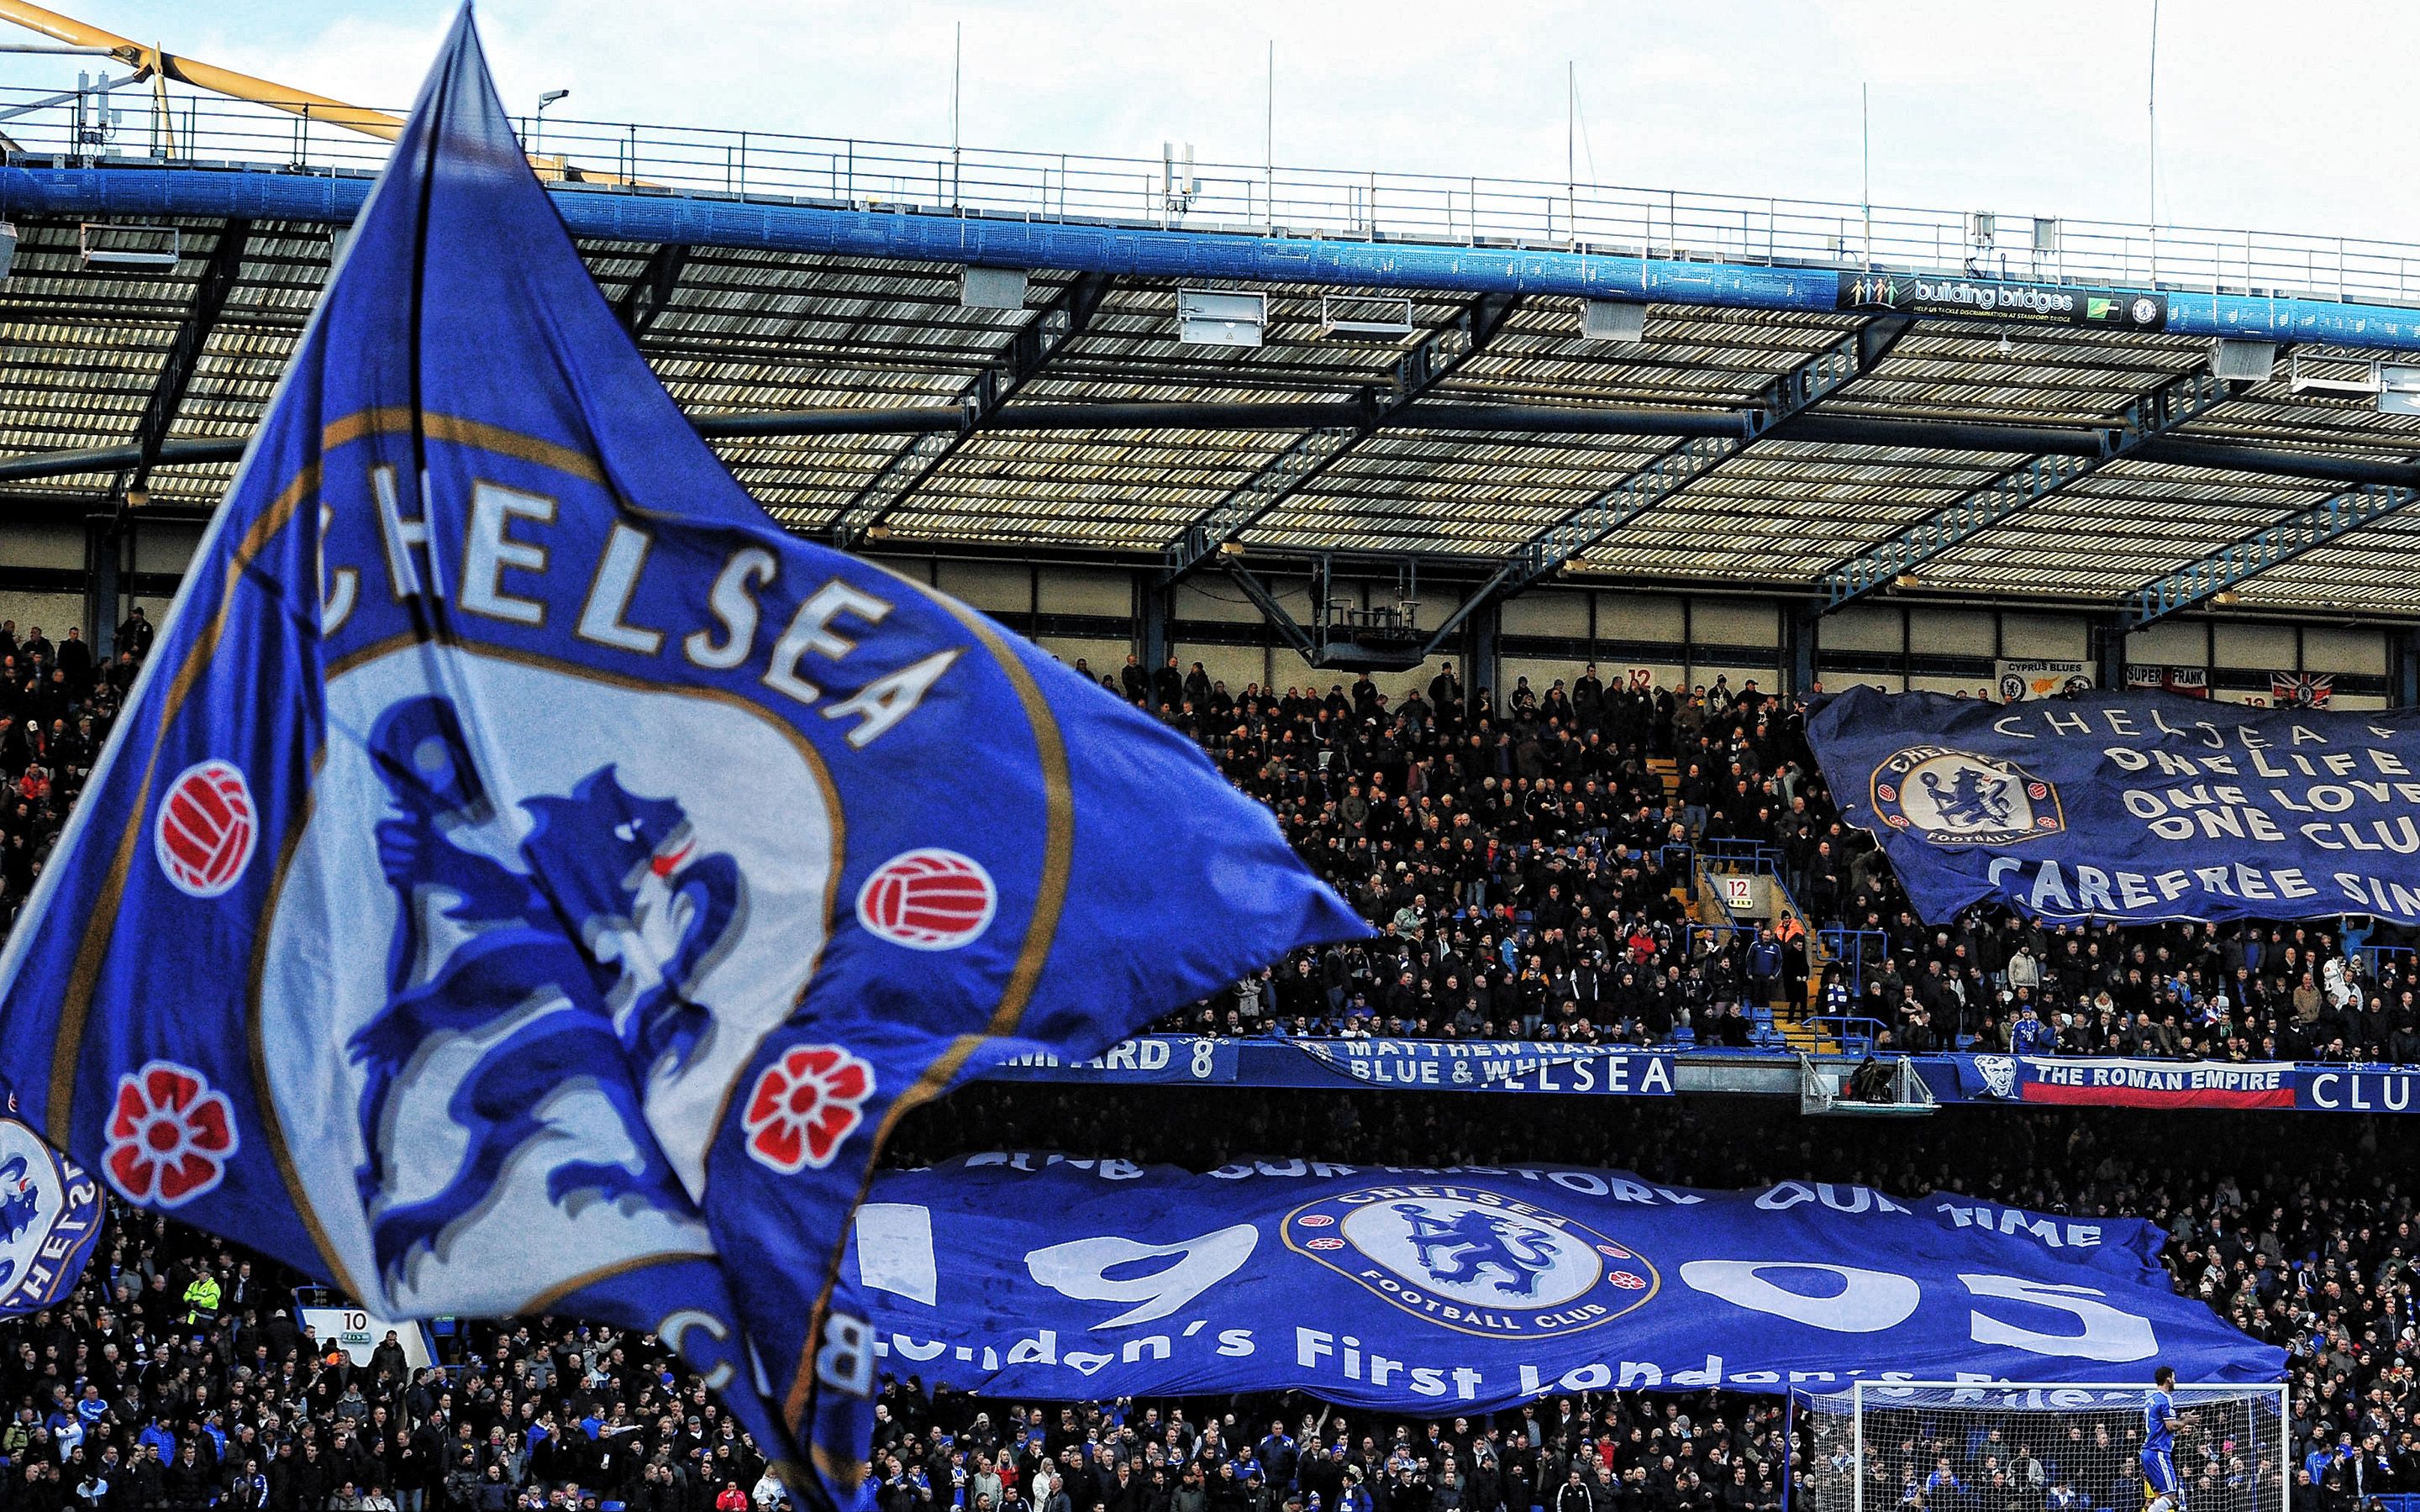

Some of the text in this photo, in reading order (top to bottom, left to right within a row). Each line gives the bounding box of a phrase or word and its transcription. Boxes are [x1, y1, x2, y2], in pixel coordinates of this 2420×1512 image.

[1915, 280, 2073, 313] building bridges
[318, 465, 968, 749] CHELSEA
[1628, 669, 1651, 689] 12
[2008, 663, 2081, 672] CYPRUS BLUES
[2128, 665, 2204, 685] SUPER FRANK
[1994, 709, 2328, 749] CHELSEA
[1890, 747, 2008, 774] CHELEA
[2103, 747, 2411, 777] ONE LIFE
[2123, 780, 2420, 819] ONE LOVE
[1926, 832, 2013, 843] FOOTBALL
[2148, 806, 2286, 841] ONE
[1728, 881, 1748, 896] 12
[1988, 857, 2317, 911] CAREFREE
[1191, 1041, 1214, 1079] 8
[1344, 1041, 1521, 1058] MATTHEW
[1350, 1059, 1439, 1084] BLUE
[1452, 1060, 1473, 1084] &
[2035, 1065, 2280, 1090] THE ROMAN EMPIRE
[1338, 1186, 1569, 1228] CHELSEA
[1937, 1202, 2101, 1247] TIME
[1360, 1269, 1607, 1330] FOOTBALL CLUB
[344, 1313, 367, 1330] 10
[1295, 1326, 1482, 1400] First
